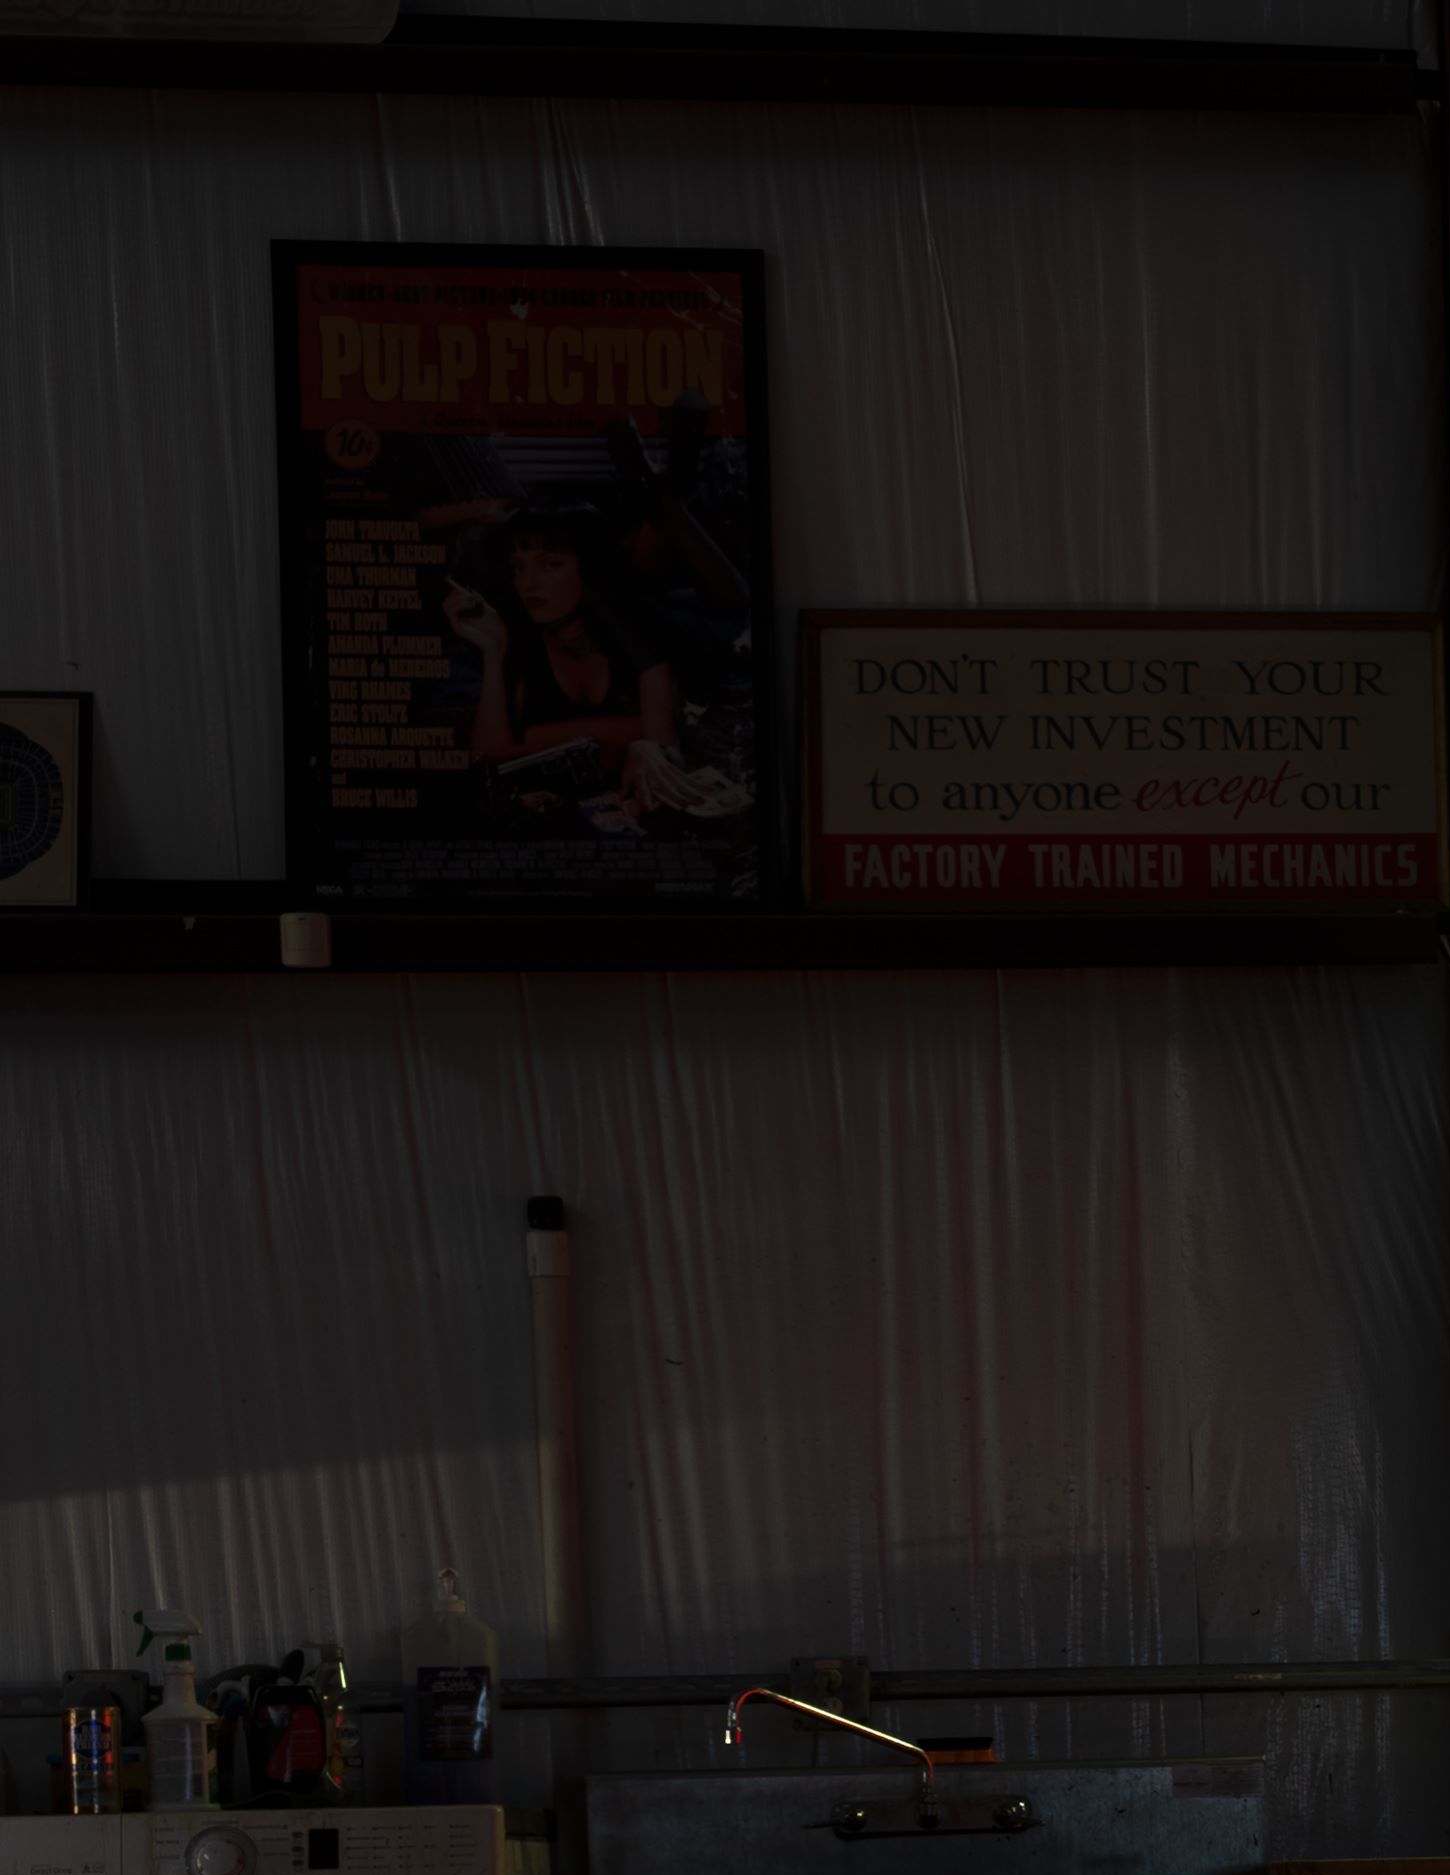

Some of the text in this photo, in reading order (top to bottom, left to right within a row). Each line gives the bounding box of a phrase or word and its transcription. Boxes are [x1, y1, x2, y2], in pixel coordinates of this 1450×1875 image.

[319, 314, 725, 407] PULP FICTION
[854, 653, 1393, 696] DON'T TRUST YOUR
[887, 714, 1360, 751] NEW INVESTMENT
[865, 760, 1391, 822] to anyone except our
[842, 842, 1419, 889] FACTORY TRAINED MECHANICS
